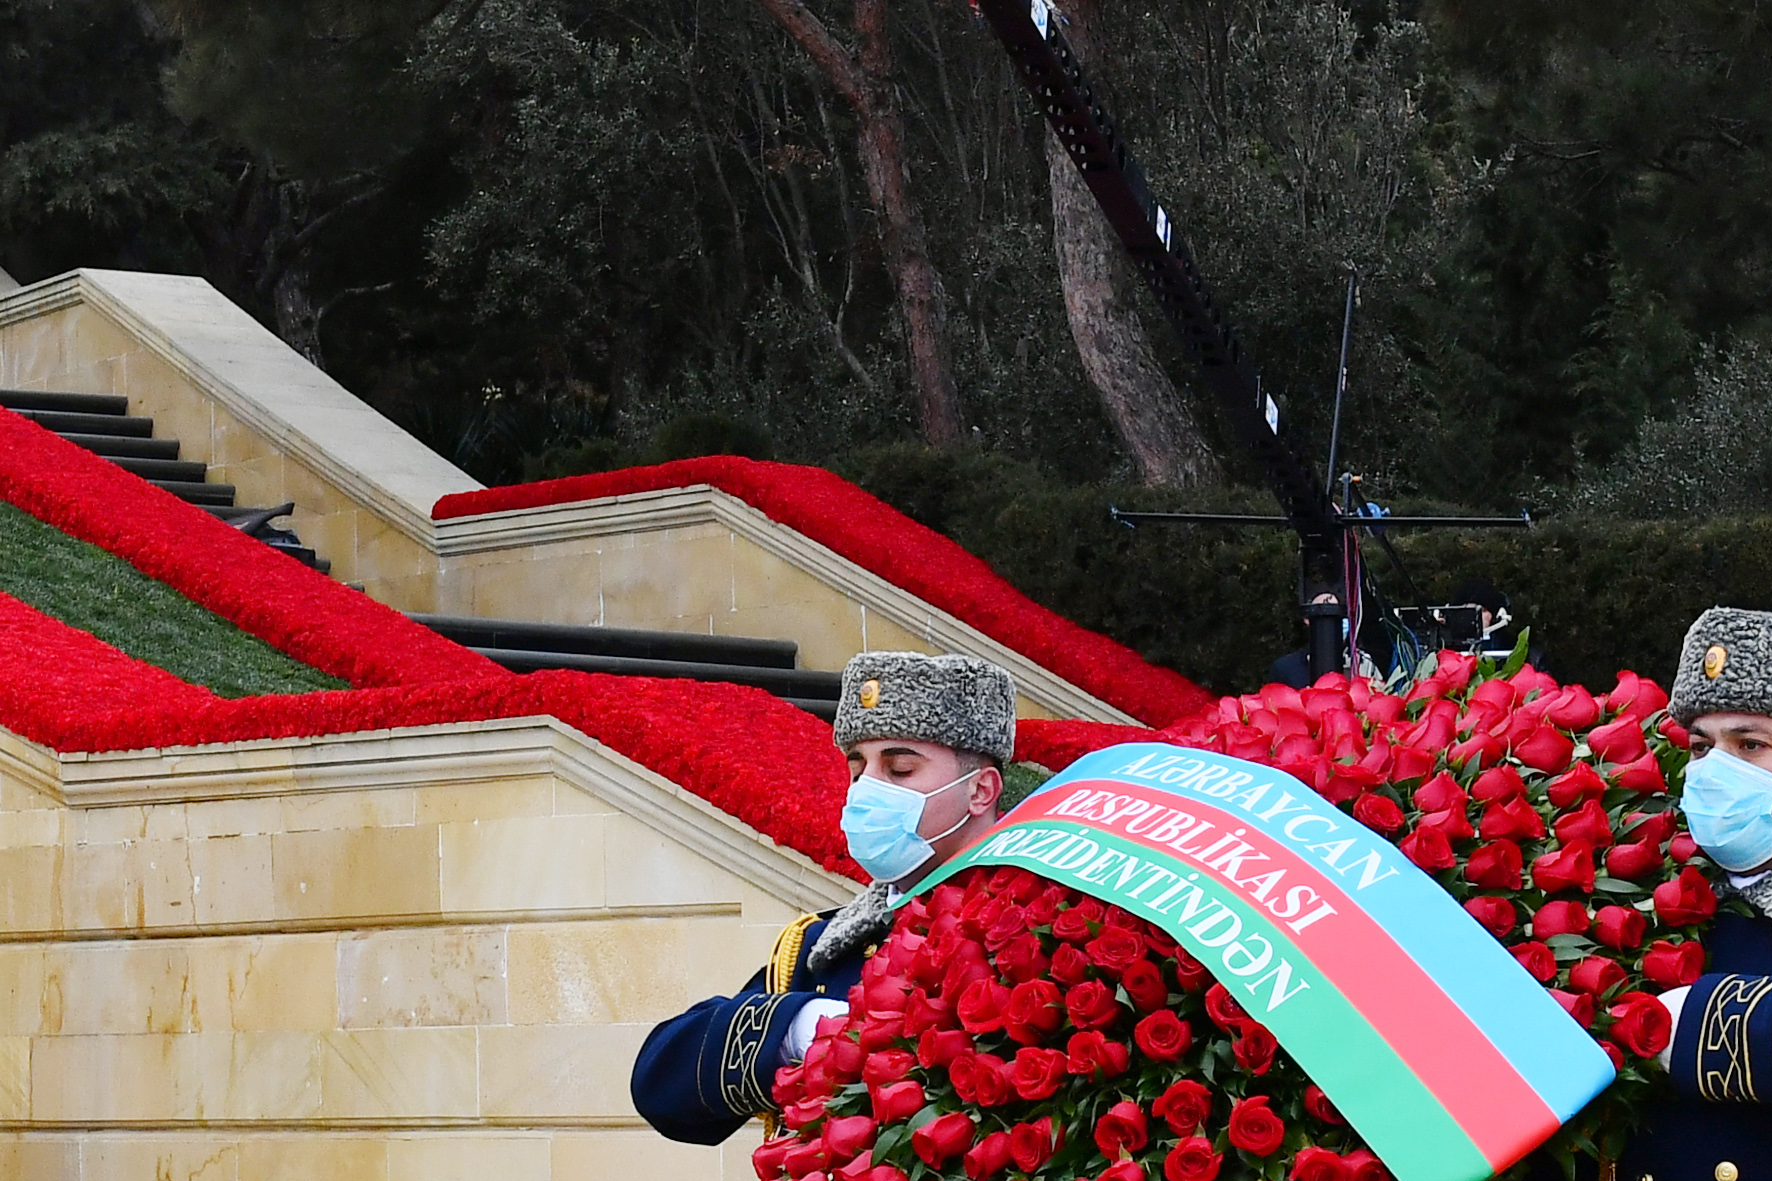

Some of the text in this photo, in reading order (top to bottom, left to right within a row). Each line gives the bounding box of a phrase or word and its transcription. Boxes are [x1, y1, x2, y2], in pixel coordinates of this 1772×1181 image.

[1044, 788, 1338, 935] RESPUBLİKASI
[1111, 752, 1399, 891] AZƏRBAYCAN
[968, 827, 1310, 1013] PREZİDENTİNDƏN
